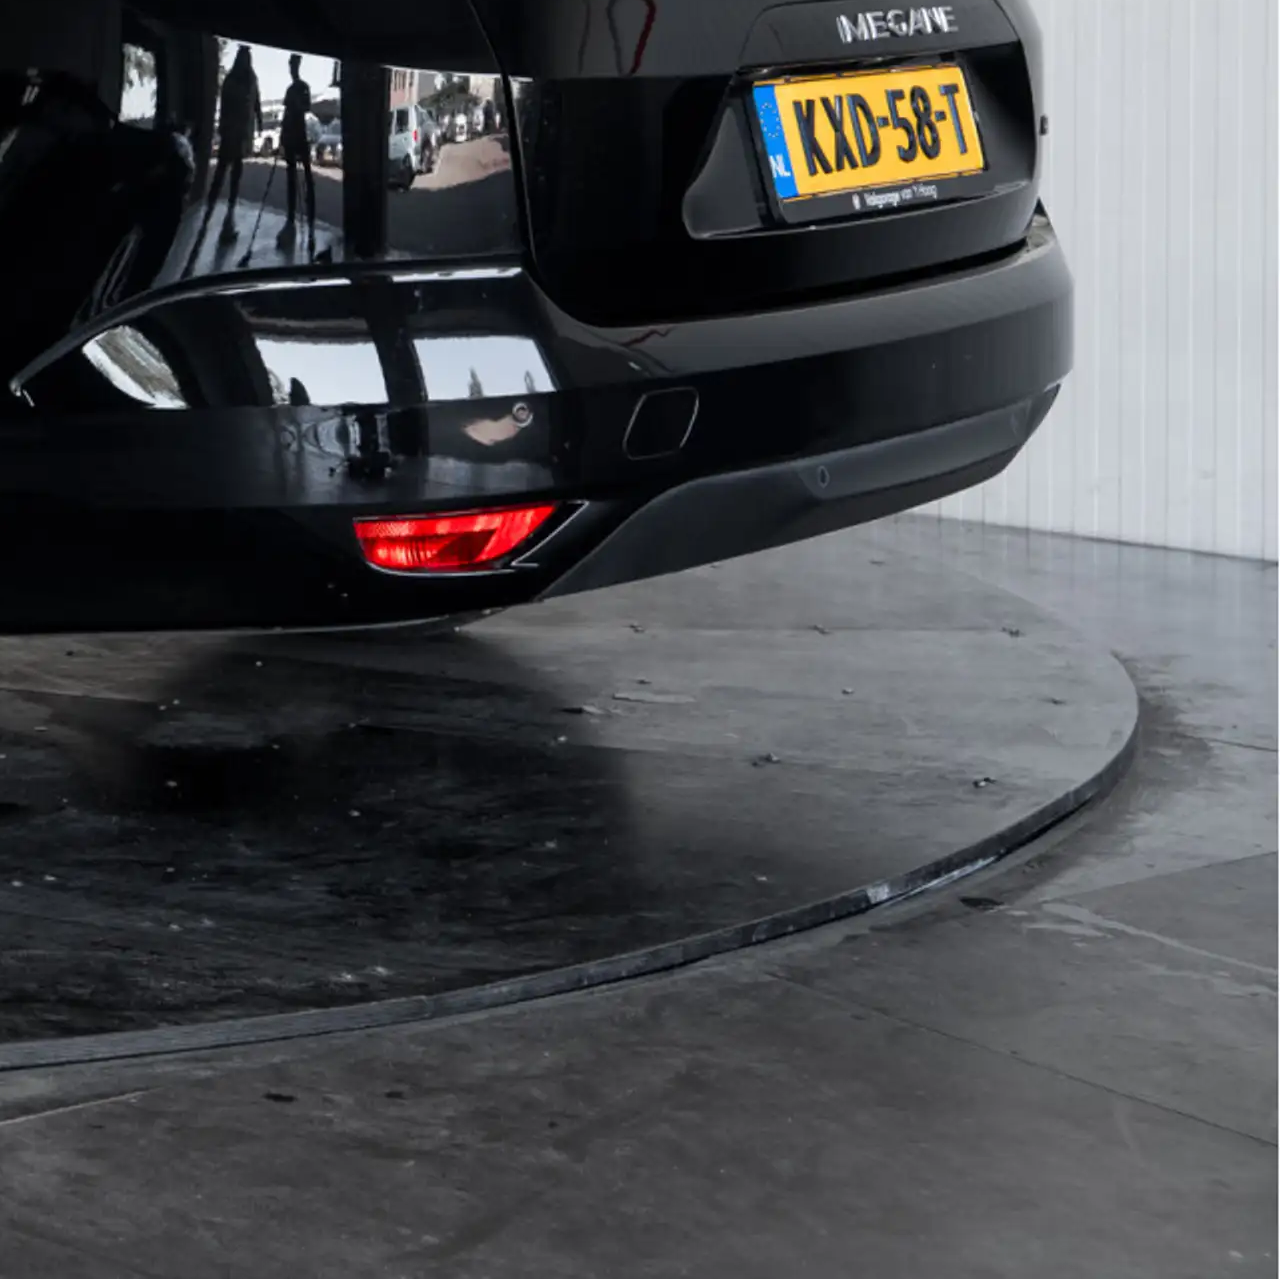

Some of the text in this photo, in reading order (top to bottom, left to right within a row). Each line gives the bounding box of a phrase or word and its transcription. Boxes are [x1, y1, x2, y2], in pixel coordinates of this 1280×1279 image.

[836, 6, 959, 43] MEGANE
[791, 83, 968, 177] KXD-58-T
[768, 154, 791, 179] NL
